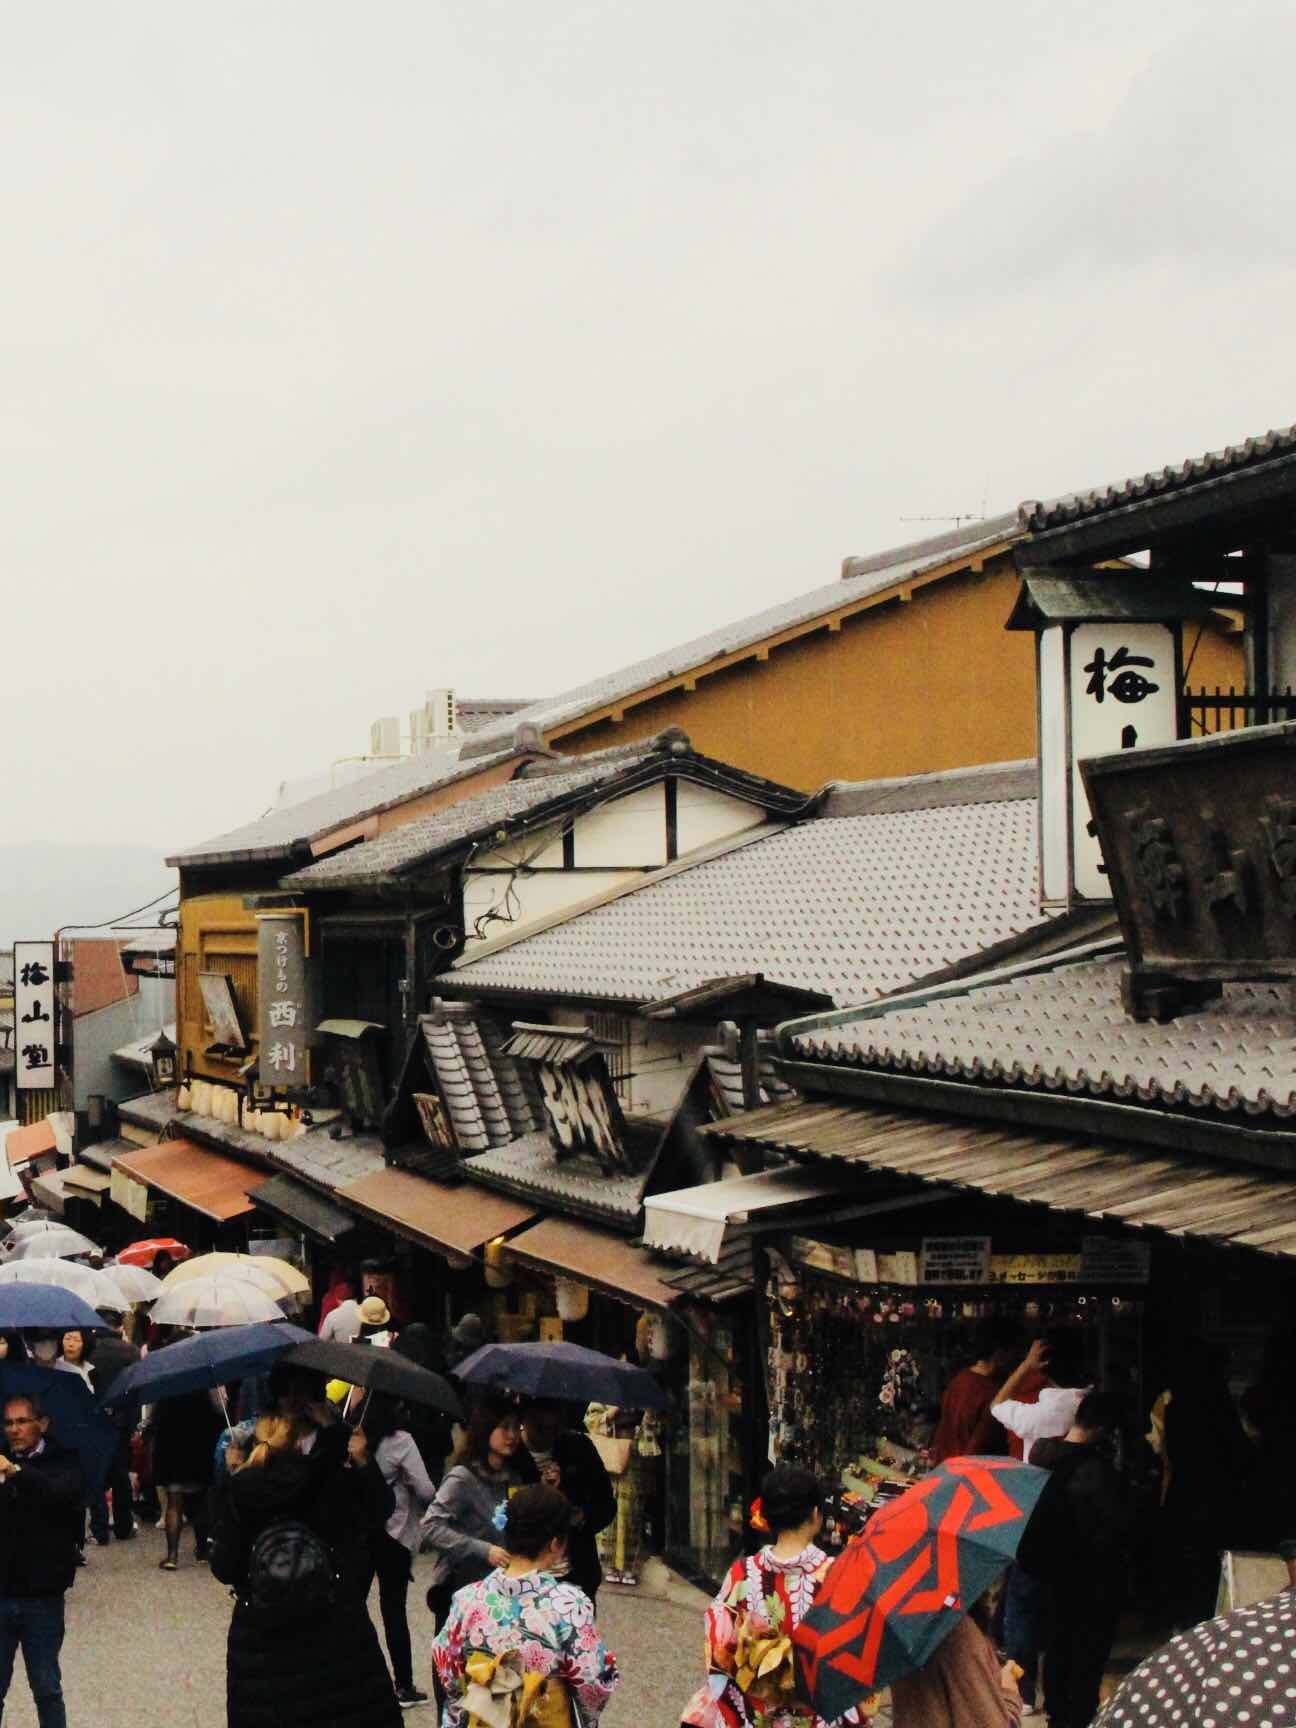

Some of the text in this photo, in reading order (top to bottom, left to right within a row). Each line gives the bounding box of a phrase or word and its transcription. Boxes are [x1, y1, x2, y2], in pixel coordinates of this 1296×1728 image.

[21, 962, 52, 1070] 梅山堂
[268, 1000, 292, 1071] 西利
